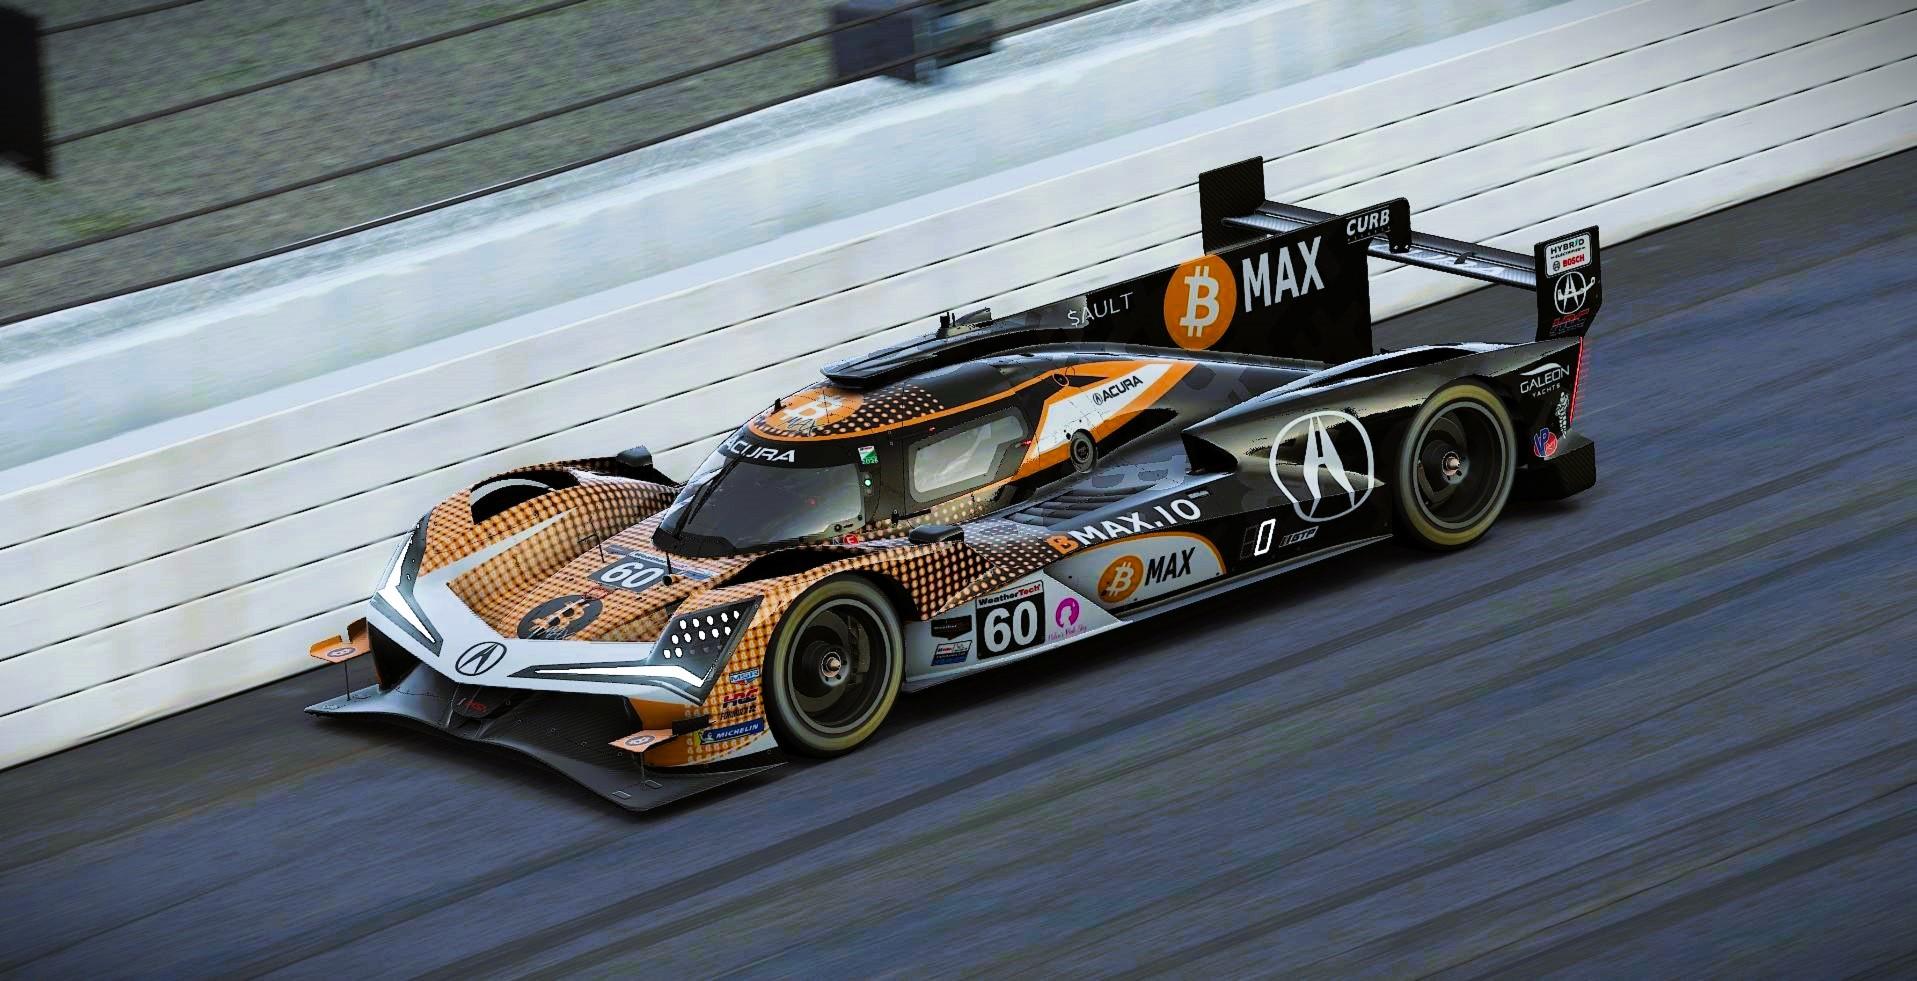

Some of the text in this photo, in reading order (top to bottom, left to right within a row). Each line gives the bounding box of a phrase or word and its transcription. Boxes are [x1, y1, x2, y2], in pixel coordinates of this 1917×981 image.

[1346, 209, 1390, 236] CURB
[1550, 238, 1585, 256] HYBRID
[1562, 254, 1585, 267] BOSCH
[1241, 236, 1325, 313] MAX
[1102, 375, 1144, 403] ACURA
[1520, 365, 1570, 394] GALEON
[1532, 382, 1561, 398] YACHTS
[725, 438, 796, 463] ACURA
[600, 561, 665, 589] 60
[1144, 547, 1196, 586] MAX
[978, 583, 1041, 606] WeatherTech
[984, 600, 1038, 653] 60
[715, 723, 759, 739] MICHELIN
